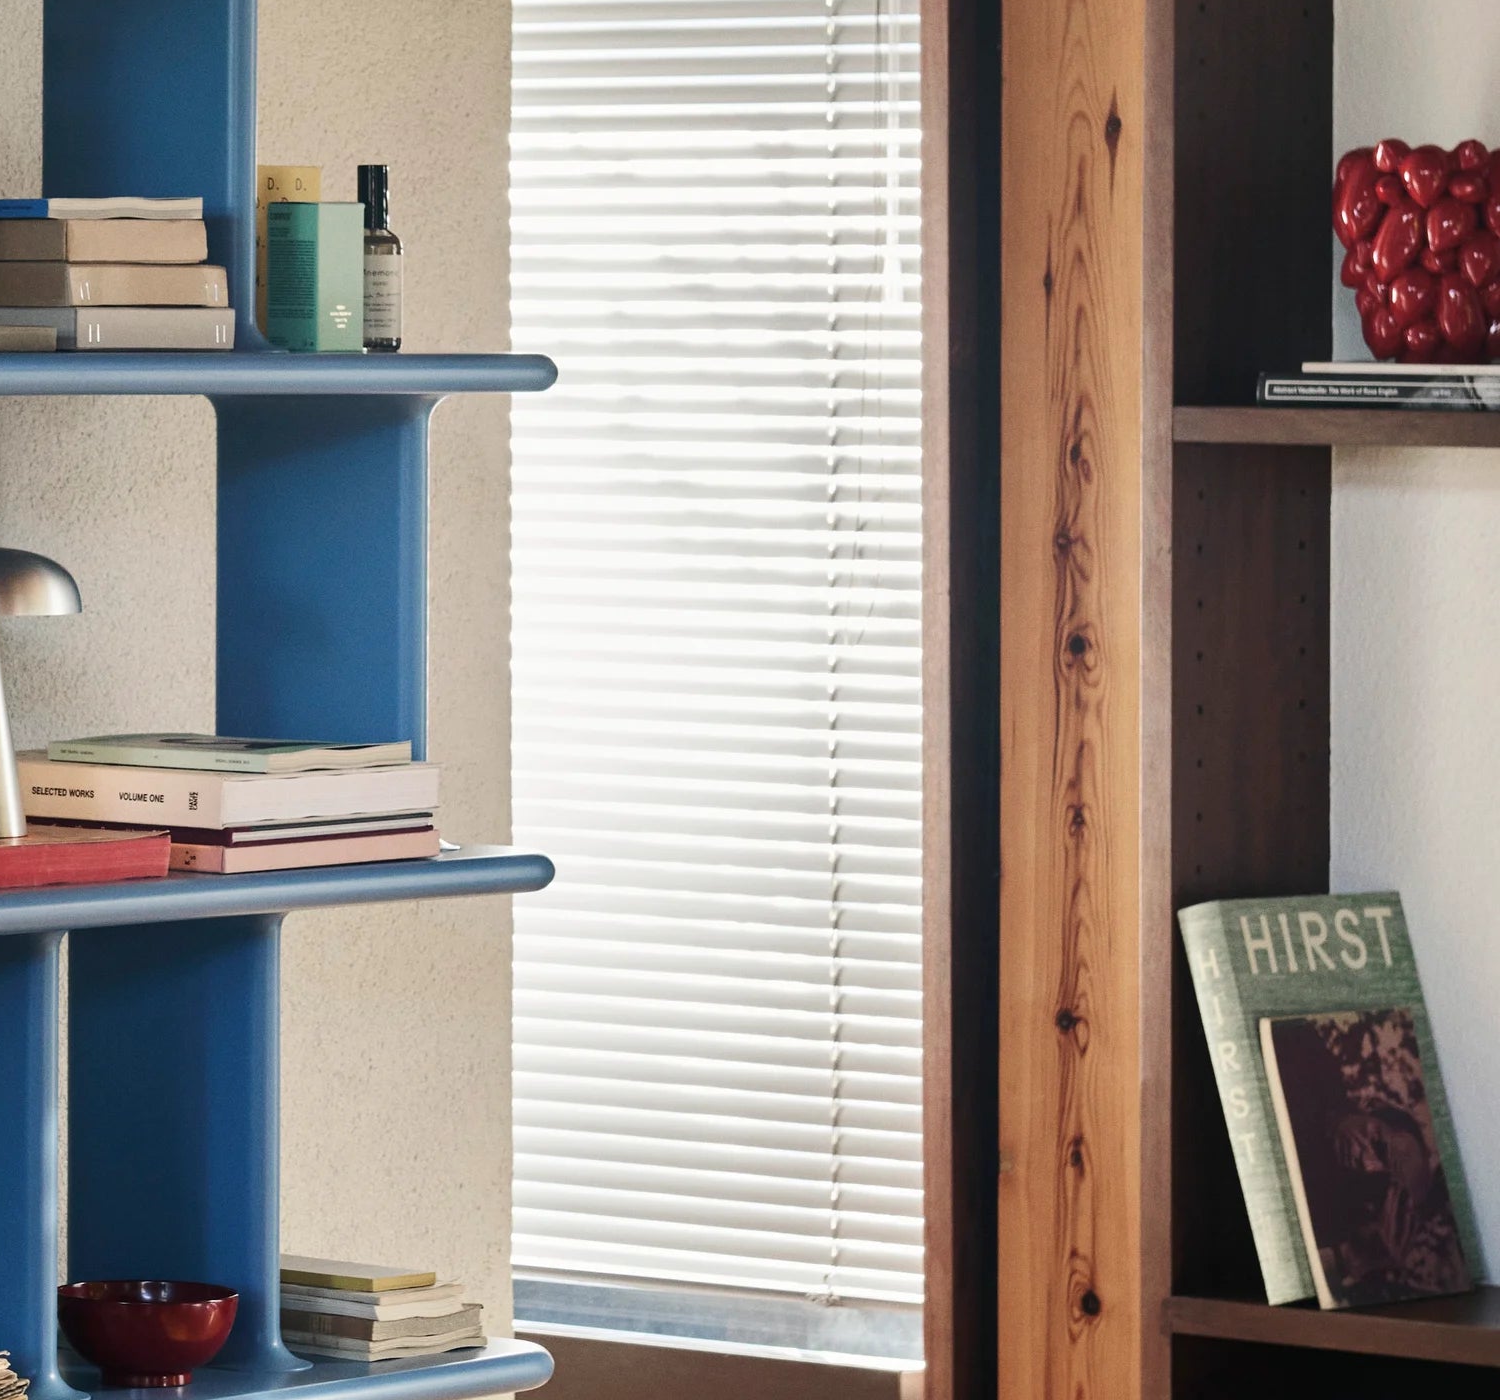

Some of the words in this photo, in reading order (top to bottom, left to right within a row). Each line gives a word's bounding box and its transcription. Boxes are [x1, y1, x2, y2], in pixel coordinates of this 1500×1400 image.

[267, 177, 280, 191] D.
[295, 178, 307, 191] D.
[31, 786, 67, 797] SELECTED
[69, 788, 95, 799] WORKS
[119, 792, 148, 802] VOLUME
[149, 794, 165, 803] ONE
[1240, 906, 1394, 975] HIRST
